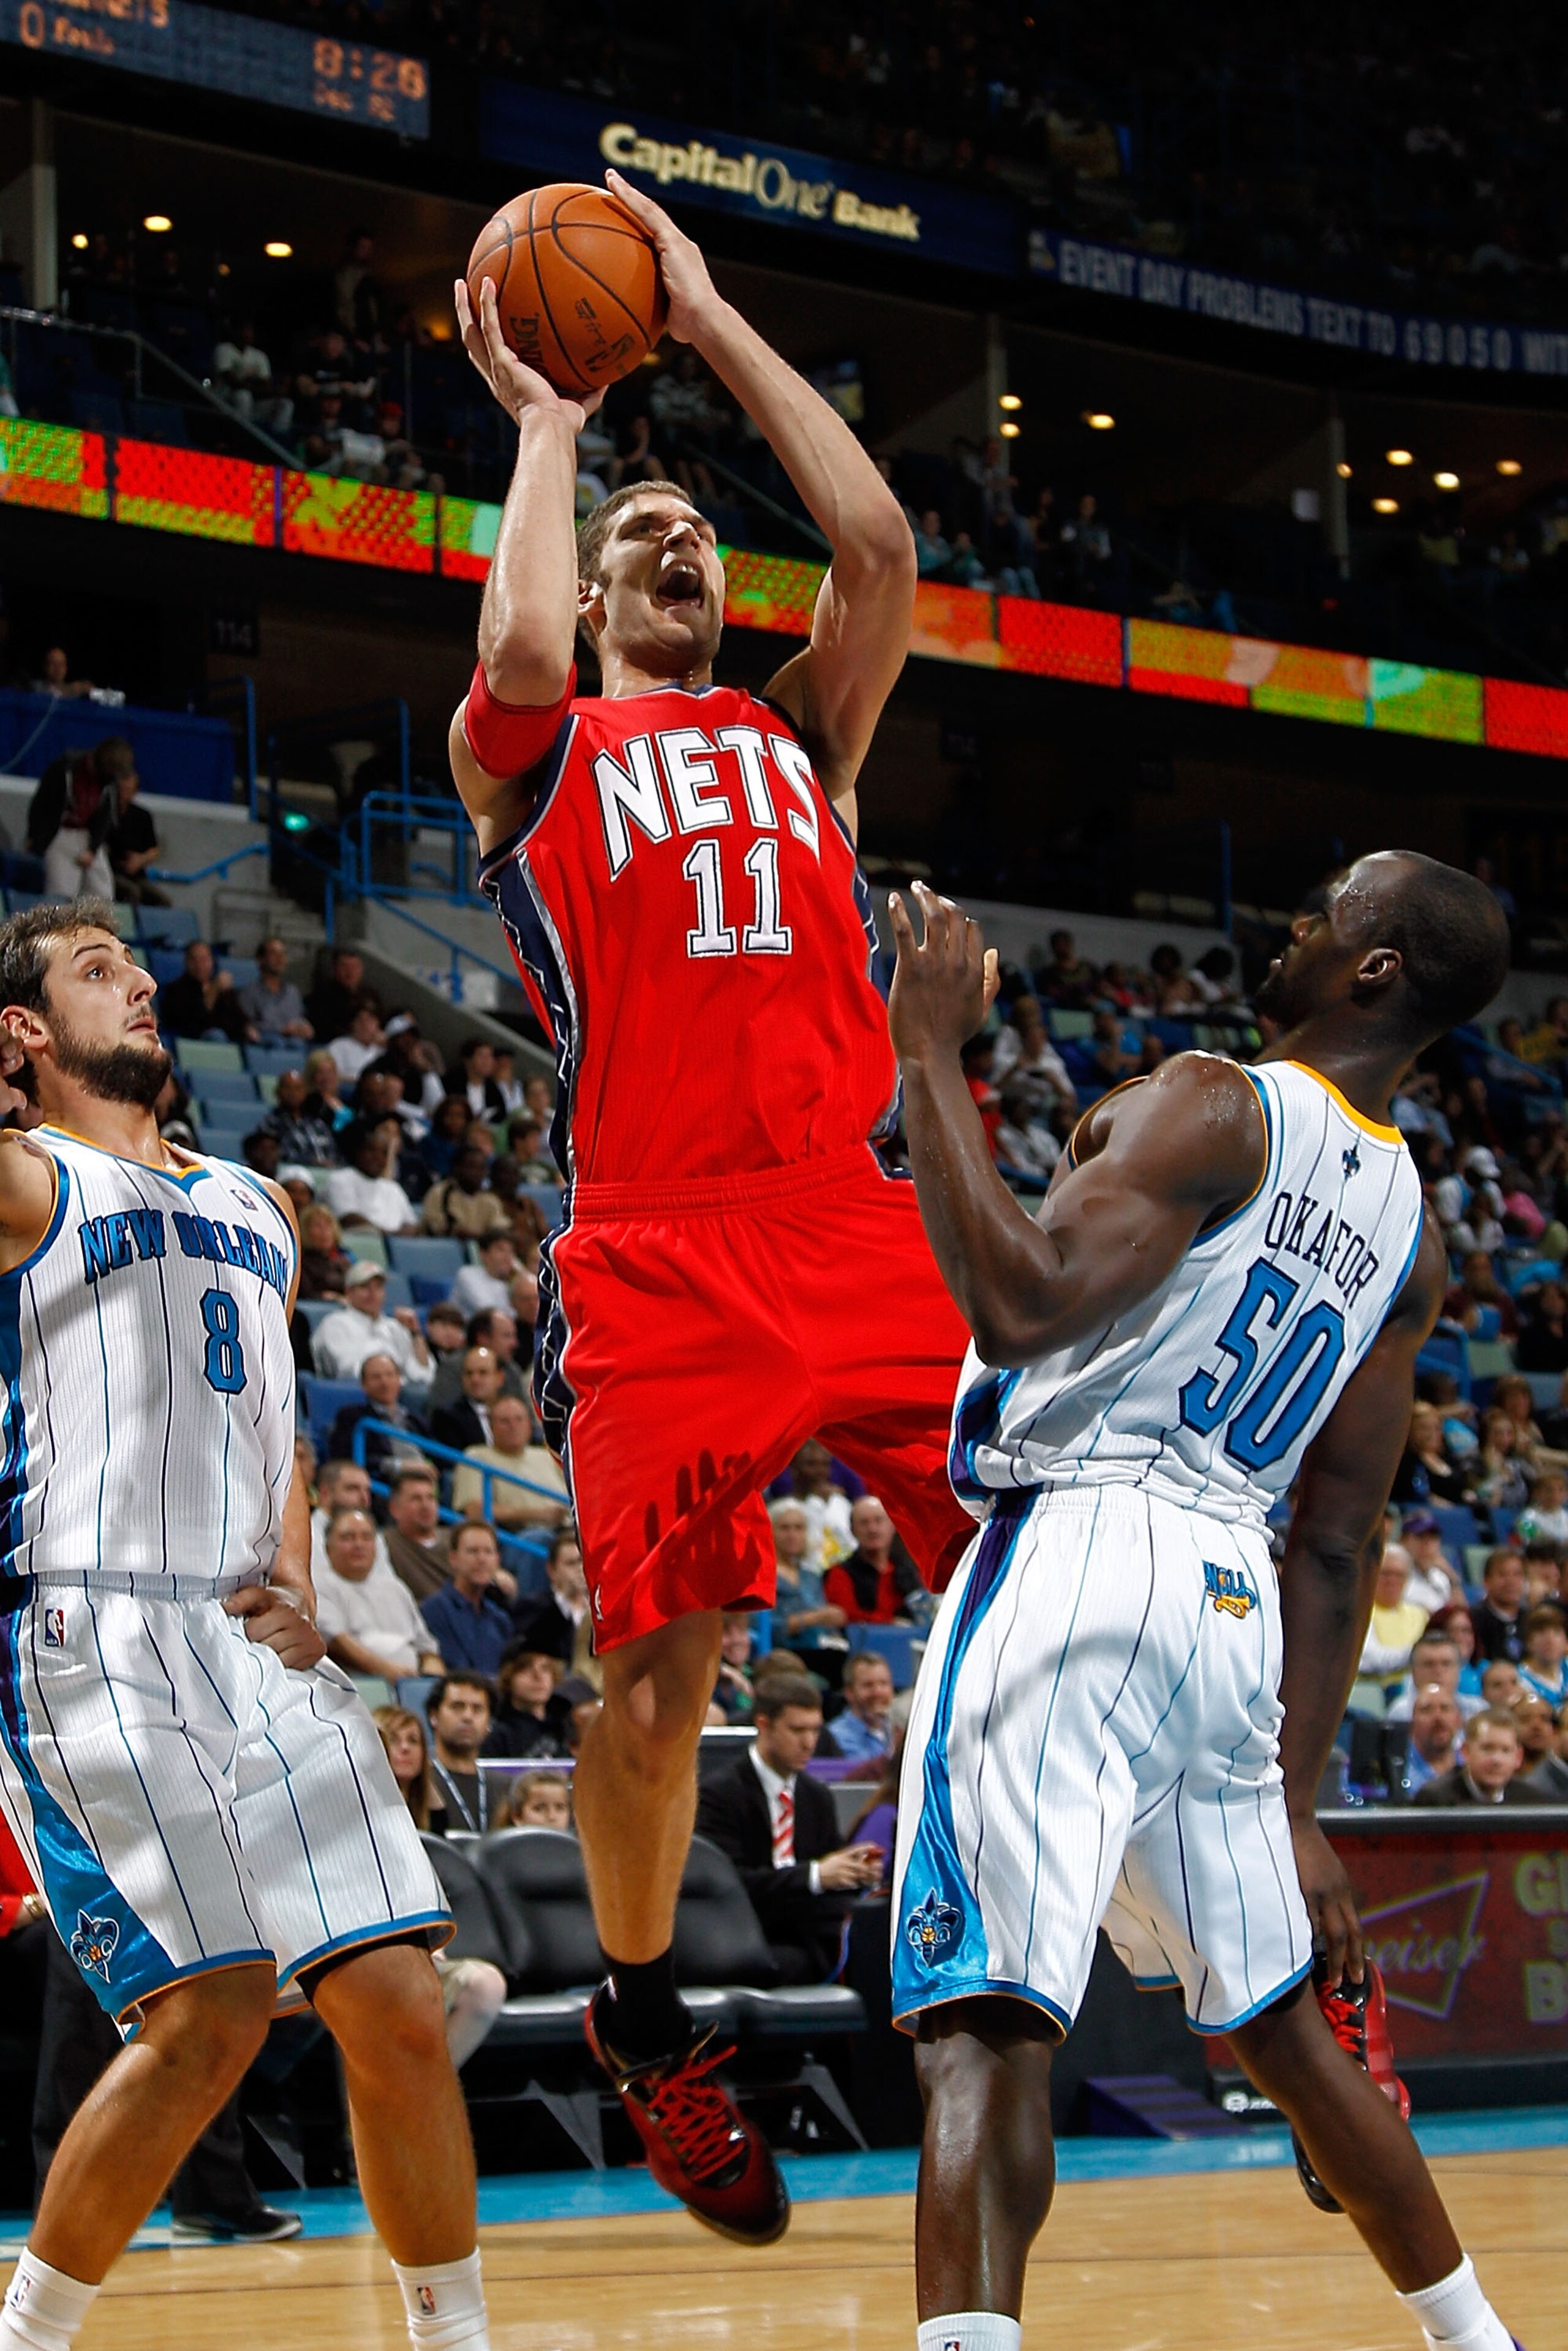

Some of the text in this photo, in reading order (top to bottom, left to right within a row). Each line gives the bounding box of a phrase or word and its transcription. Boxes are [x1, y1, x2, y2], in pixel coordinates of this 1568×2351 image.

[833, 191, 919, 241] Bank
[1059, 239, 1136, 297] EVENT
[1139, 258, 1185, 308] DAY
[1187, 269, 1304, 336] PROBLEMS
[1306, 296, 1362, 348] TEXT
[1366, 311, 1396, 357] TO
[590, 724, 821, 883] NETS
[682, 837, 793, 958] 11
[78, 1209, 167, 1285] NEW
[1264, 1191, 1380, 1309] OKAFOR
[199, 1288, 247, 1395] 8
[1178, 1256, 1346, 1472] 50
[1513, 1853, 1568, 1917] G
